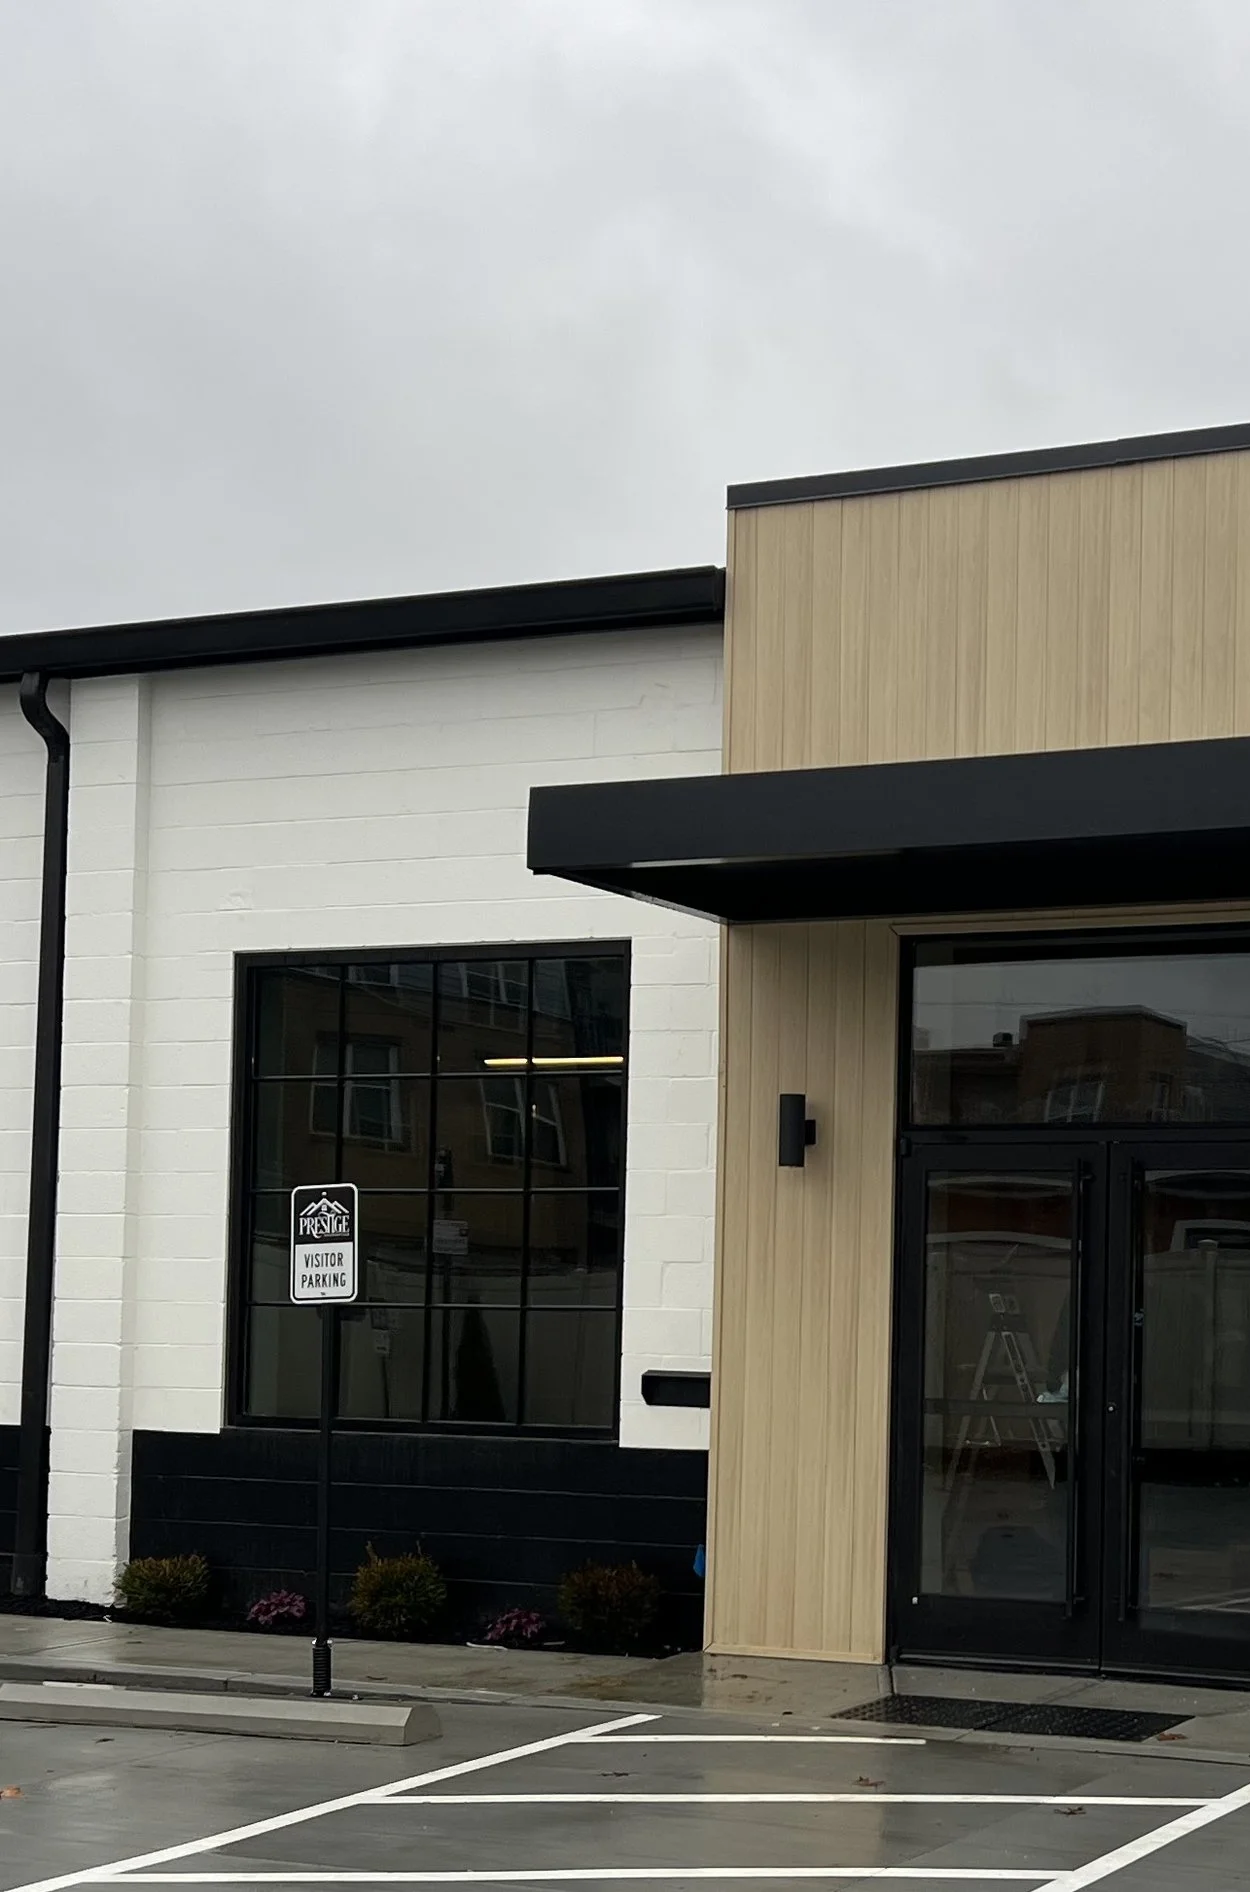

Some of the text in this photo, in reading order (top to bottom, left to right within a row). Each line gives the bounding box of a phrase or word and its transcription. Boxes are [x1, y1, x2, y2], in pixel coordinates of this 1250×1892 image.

[299, 1212, 350, 1238] PRESTIGE
[304, 1252, 344, 1269] VISITOR
[301, 1272, 346, 1289] PARKING
